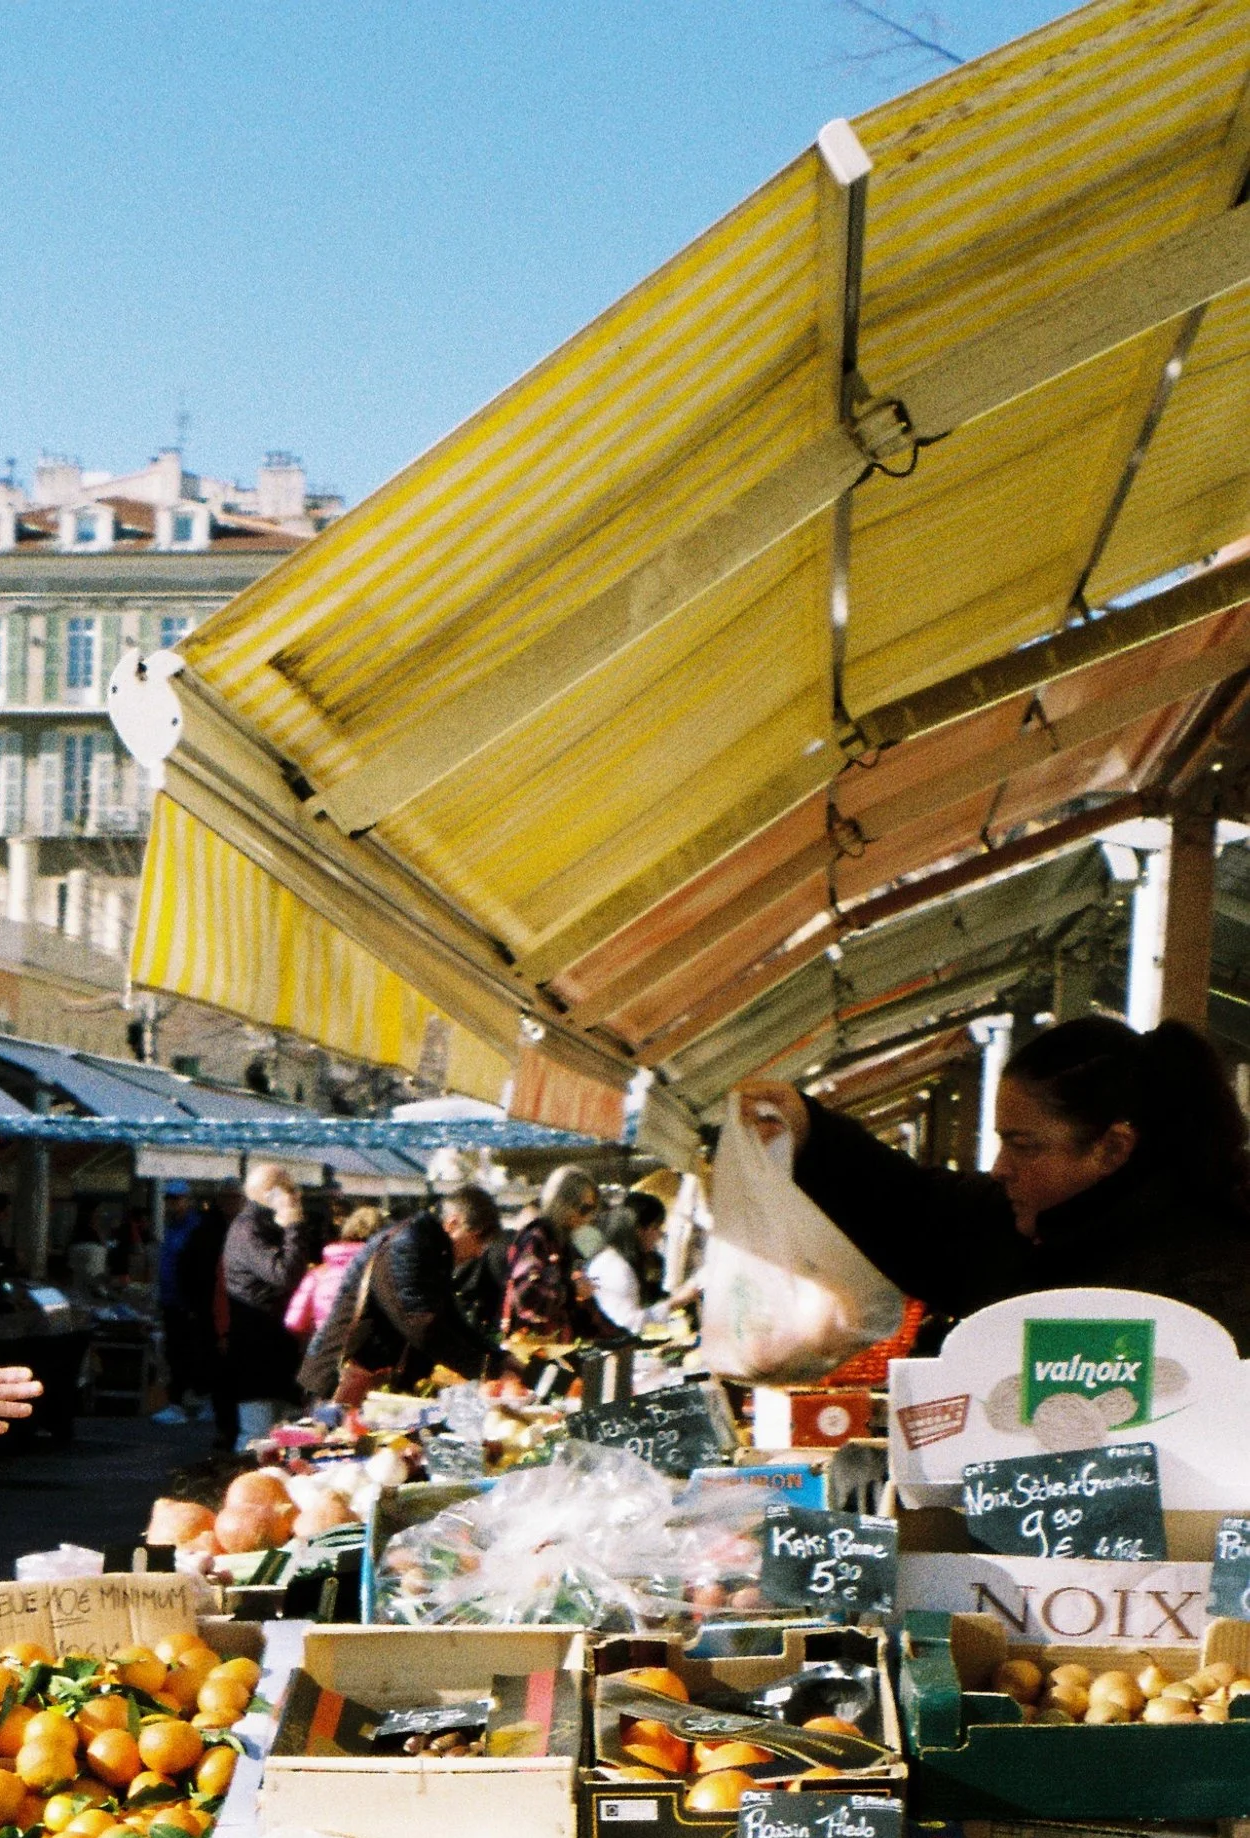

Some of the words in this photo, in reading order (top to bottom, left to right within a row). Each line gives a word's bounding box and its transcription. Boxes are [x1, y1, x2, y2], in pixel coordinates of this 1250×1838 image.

[1034, 1353, 1142, 1389] valnoix
[964, 1481, 1013, 1516] Noix
[1081, 1462, 1156, 1497] Grenoble
[100, 1582, 188, 1616] MINIMUM
[970, 1582, 1201, 1640] NOIX
